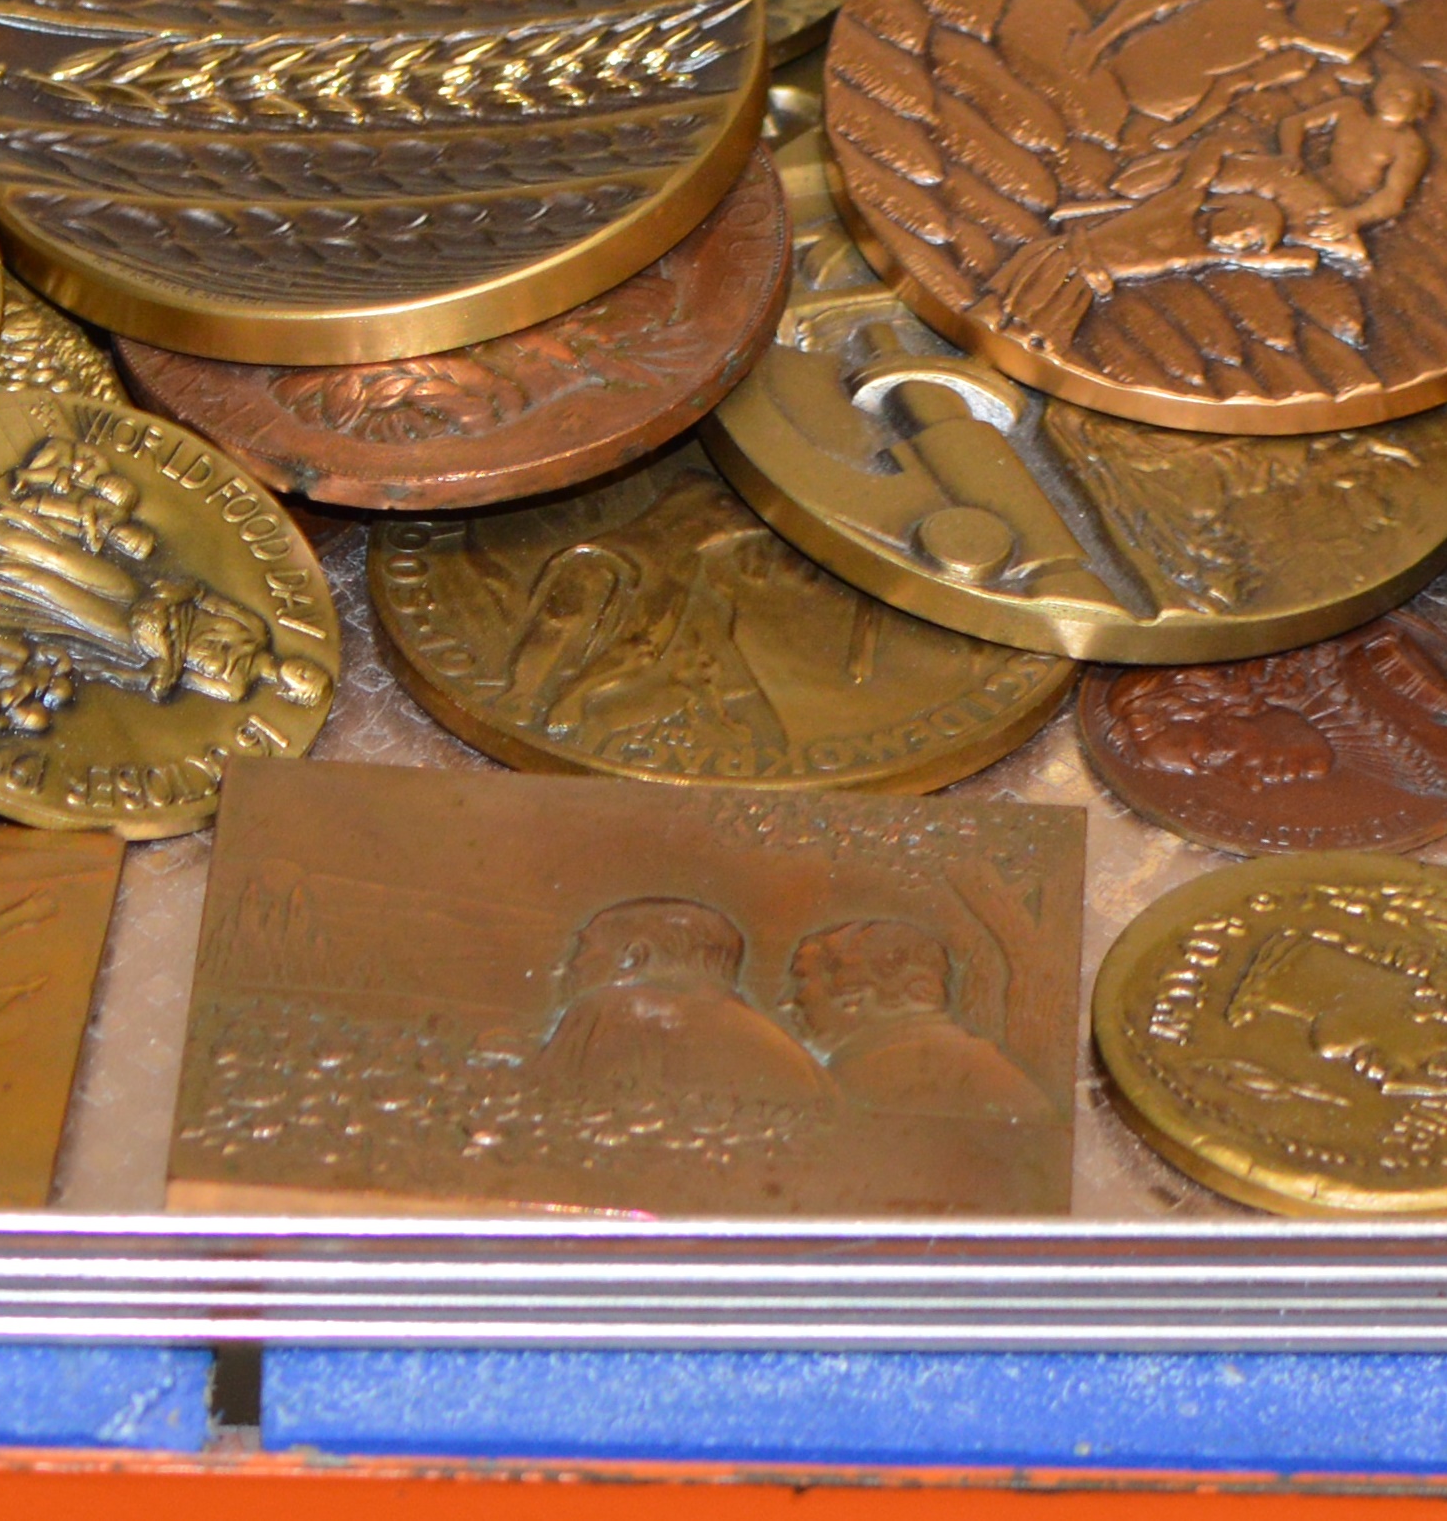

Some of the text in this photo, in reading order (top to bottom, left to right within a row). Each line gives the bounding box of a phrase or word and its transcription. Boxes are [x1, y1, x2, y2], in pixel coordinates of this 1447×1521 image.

[72, 403, 329, 643] WORLD FOOD DAY
